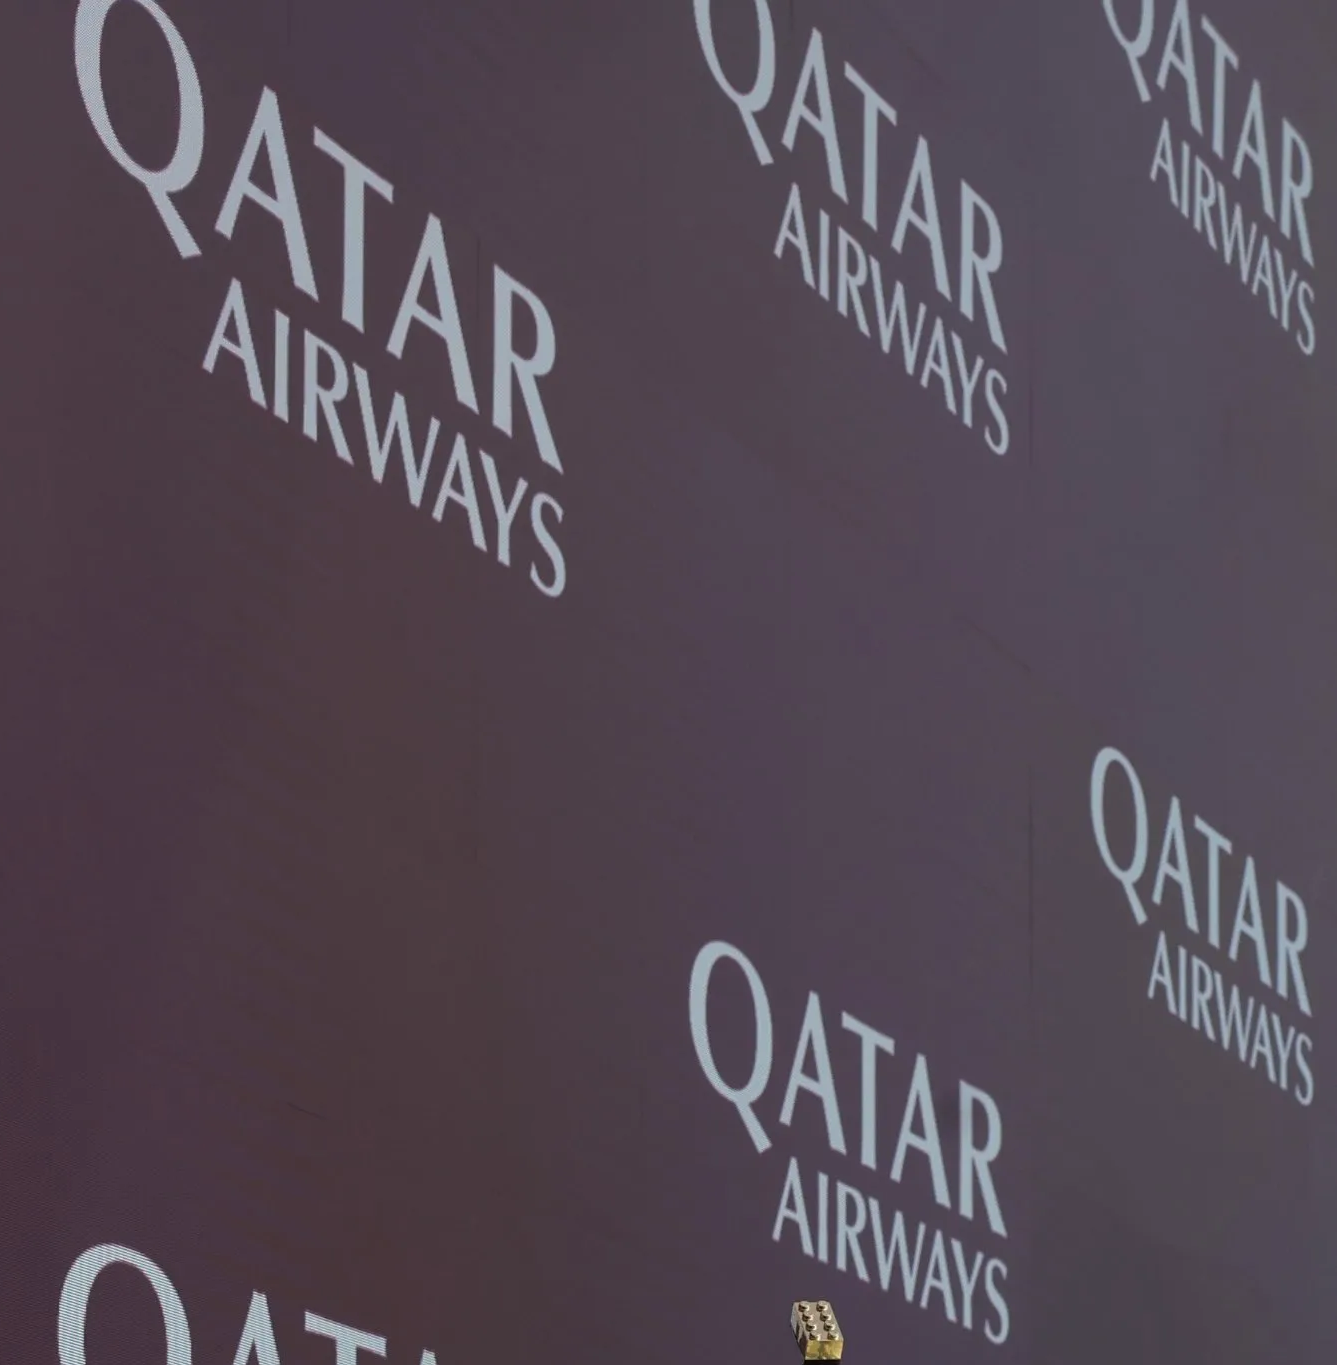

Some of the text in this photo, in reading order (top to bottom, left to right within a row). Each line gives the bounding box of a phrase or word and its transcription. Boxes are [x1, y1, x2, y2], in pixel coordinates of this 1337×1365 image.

[74, 0, 563, 475] QATAR
[693, 0, 1008, 355] QATAR
[1149, 118, 1316, 356] AIRWAYS
[202, 276, 566, 597] AIRWAYS
[773, 182, 1010, 455] AIRWAYS
[1089, 746, 1312, 1018] QATAR
[1147, 930, 1315, 1106] AIRWAYS
[688, 939, 1008, 1239] QATAR
[772, 1156, 1010, 1344] AIRWAYS
